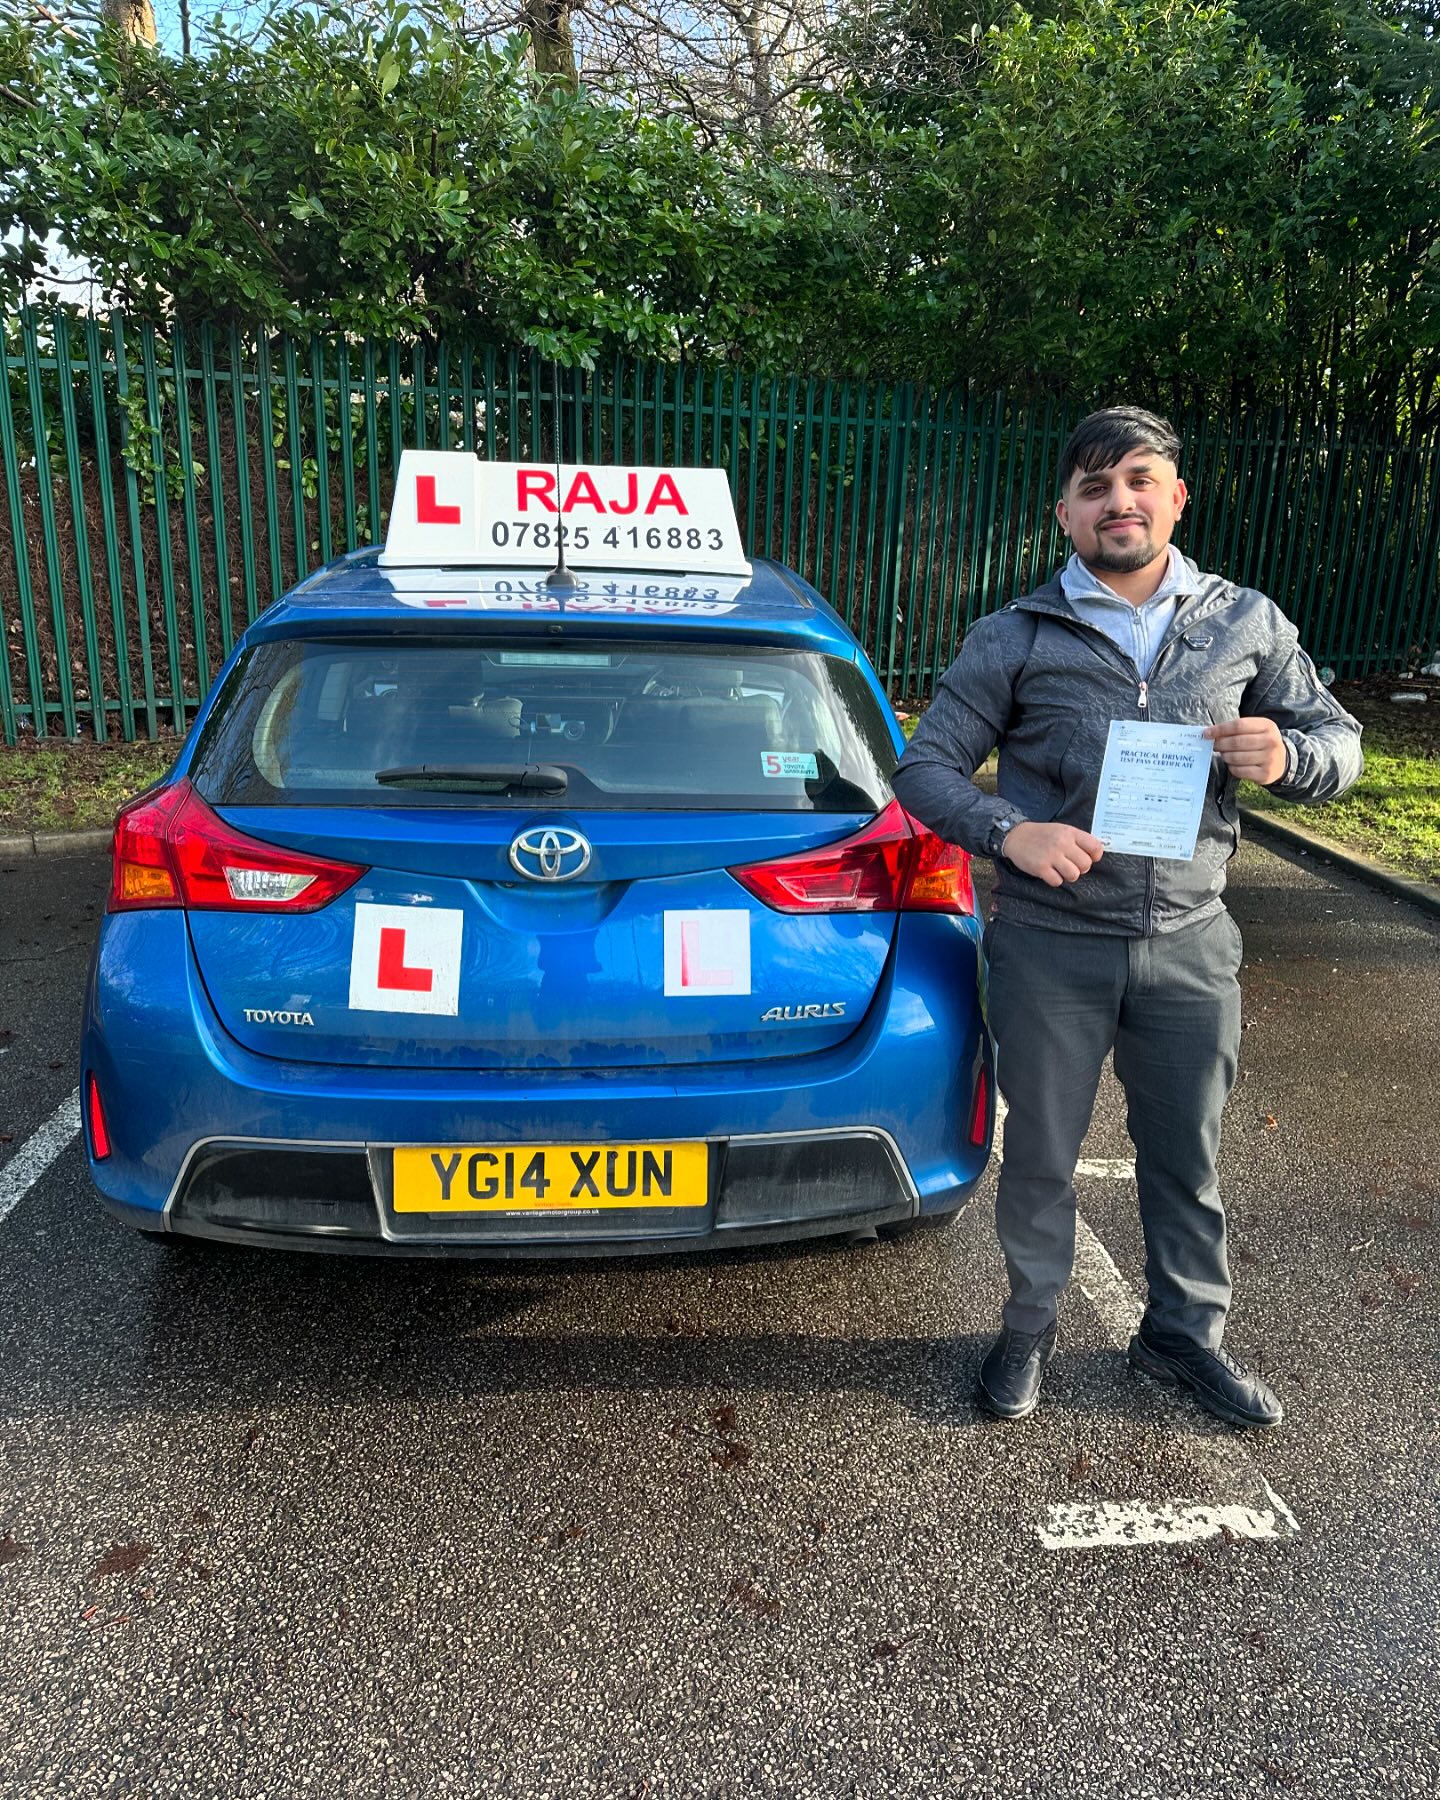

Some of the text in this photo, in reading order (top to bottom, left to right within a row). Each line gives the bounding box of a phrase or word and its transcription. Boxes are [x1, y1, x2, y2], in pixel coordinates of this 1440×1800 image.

[415, 475, 461, 525] L
[516, 469, 689, 516] RAJA
[491, 520, 724, 551] 07825 416883
[766, 755, 782, 775] 5
[1120, 749, 1195, 762] PRACTICAL DRIVING
[1153, 760, 1193, 769] CERTIFICATE
[377, 927, 433, 992] L
[680, 920, 734, 987] L
[243, 1008, 315, 1026] TOYOTA
[760, 1002, 847, 1022] AURIS
[430, 1150, 673, 1201] YG14 XUN
